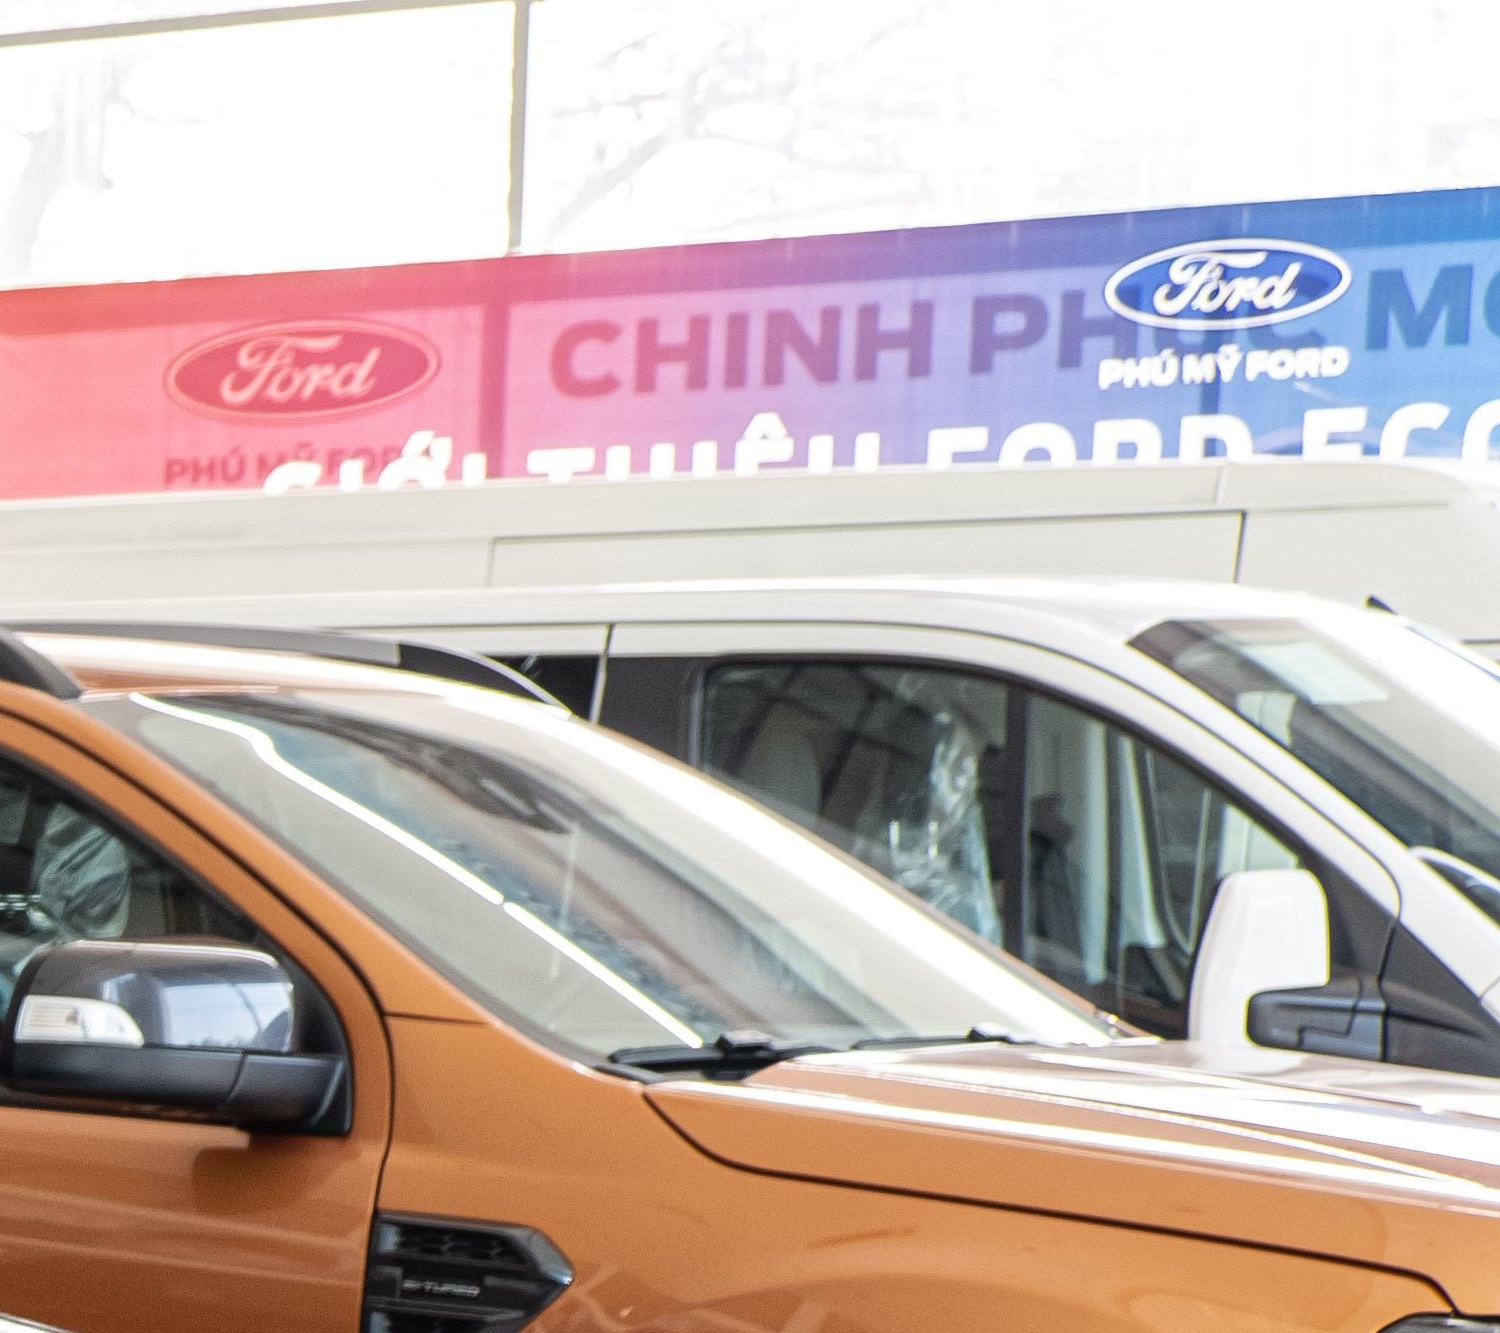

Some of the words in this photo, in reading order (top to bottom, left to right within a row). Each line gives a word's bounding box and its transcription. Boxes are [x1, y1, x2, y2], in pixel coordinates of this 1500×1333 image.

[1153, 250, 1303, 316] Ford
[549, 298, 935, 397] CHINH
[1365, 263, 1500, 350] M
[219, 334, 382, 405] Ford
[1097, 346, 1179, 390] PHÚ
[1182, 343, 1244, 384] MỸ
[1245, 345, 1349, 382] FORD
[164, 446, 246, 485] PHÚ
